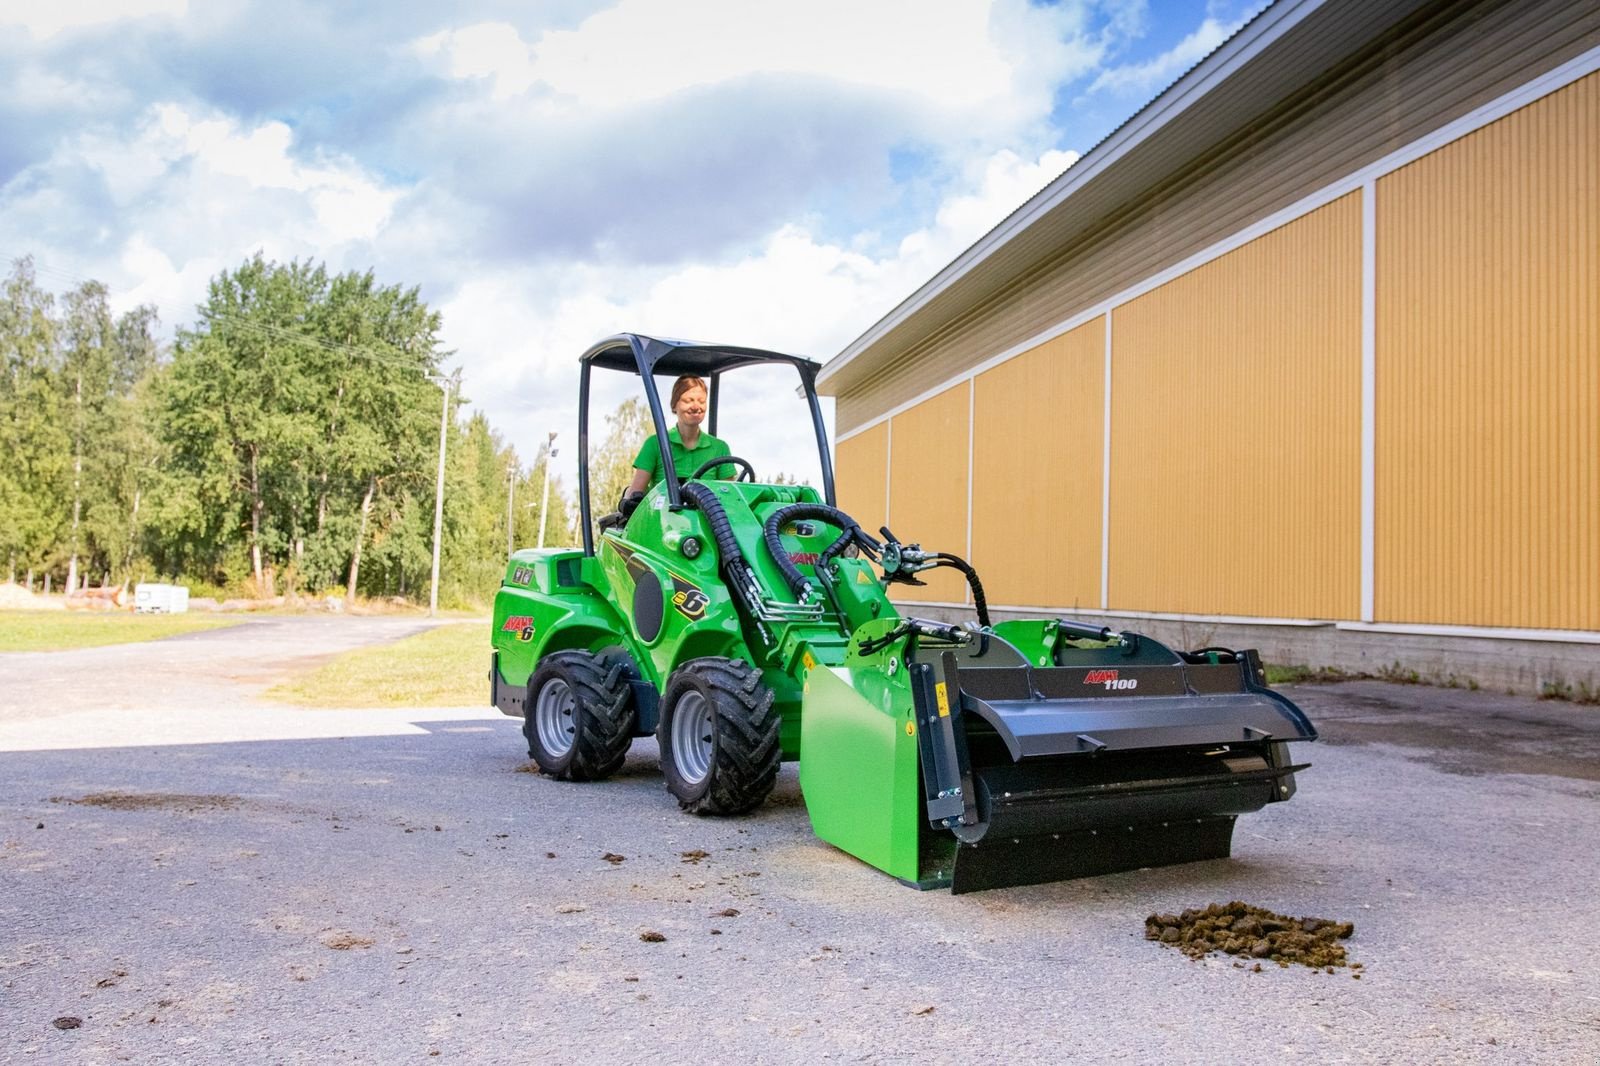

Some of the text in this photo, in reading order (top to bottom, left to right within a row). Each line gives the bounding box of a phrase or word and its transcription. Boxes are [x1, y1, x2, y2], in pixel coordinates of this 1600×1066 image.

[788, 552, 820, 566] VANT
[502, 615, 534, 631] AVANT
[1083, 669, 1119, 684] AVANT
[1105, 679, 1138, 690] 1100
